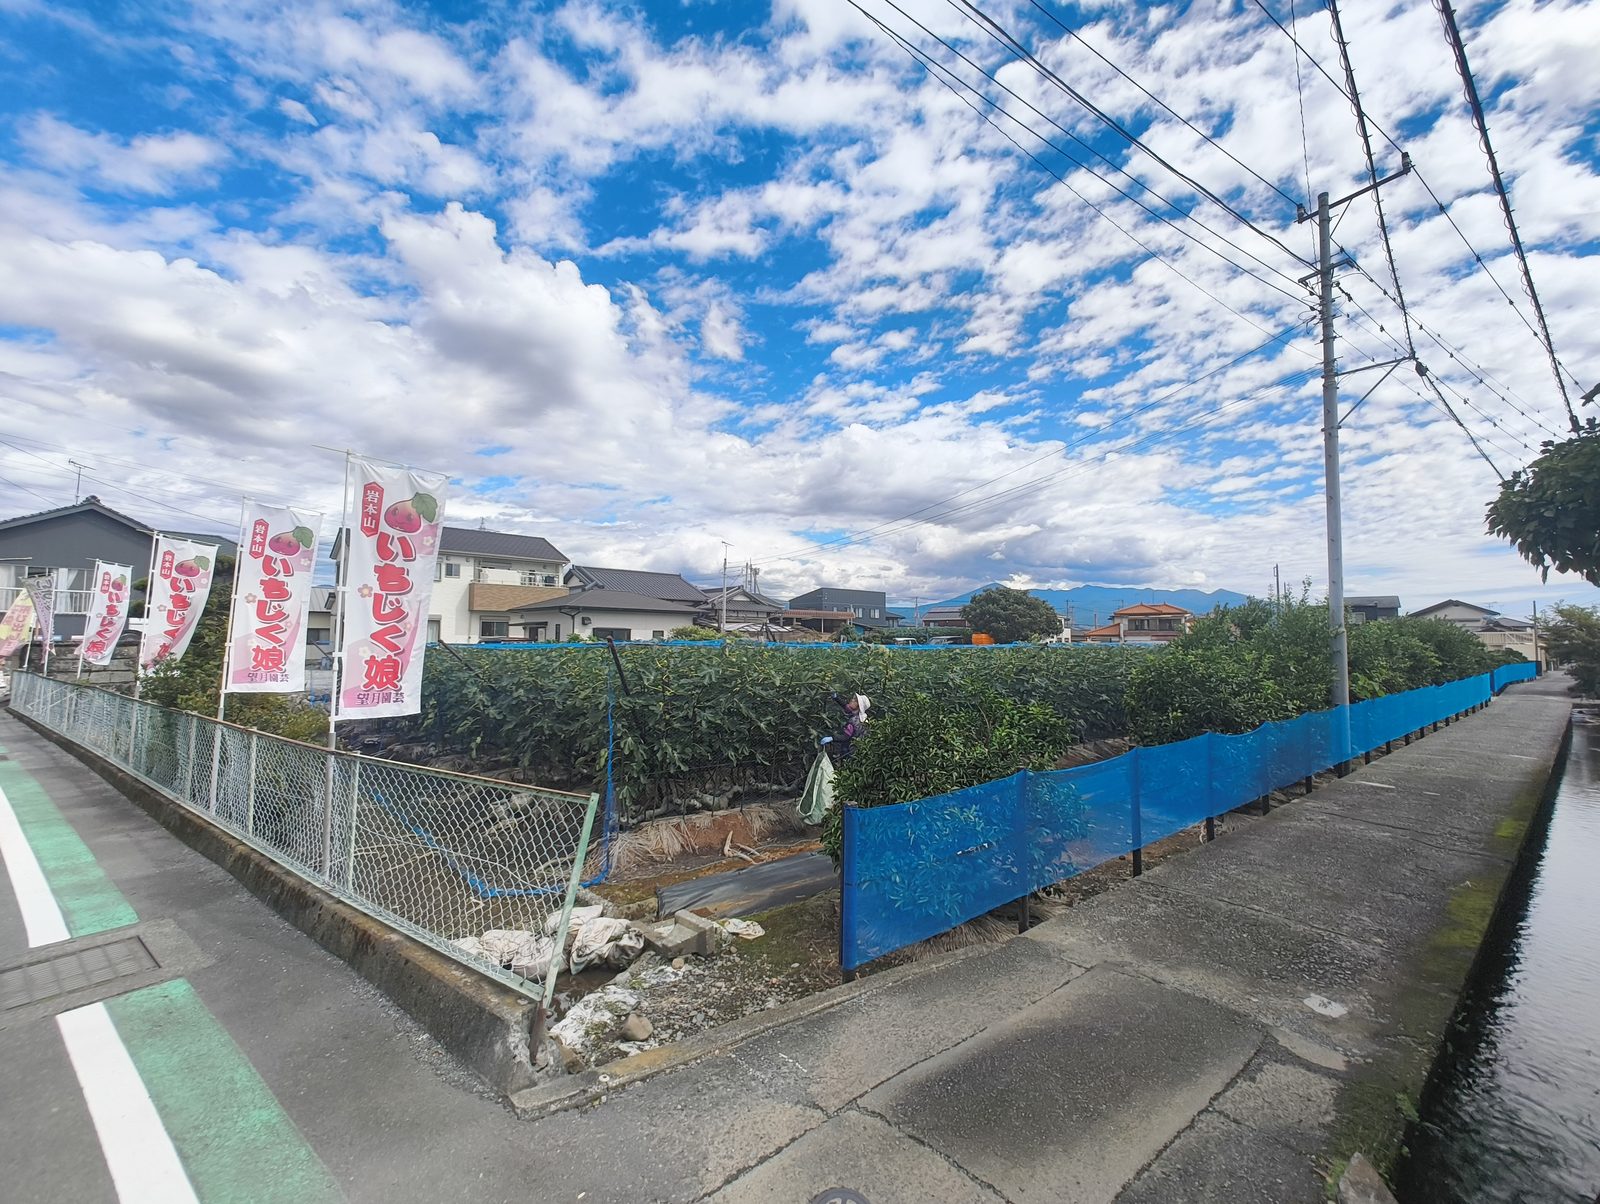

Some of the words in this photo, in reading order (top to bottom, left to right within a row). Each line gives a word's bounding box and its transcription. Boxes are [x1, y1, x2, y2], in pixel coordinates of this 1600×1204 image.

[363, 490, 380, 529] 岩本山
[252, 523, 266, 553] 岩本山
[250, 554, 293, 673] いちじく娘
[362, 530, 416, 691] いちじく娘
[356, 691, 405, 705] 望月園芸
